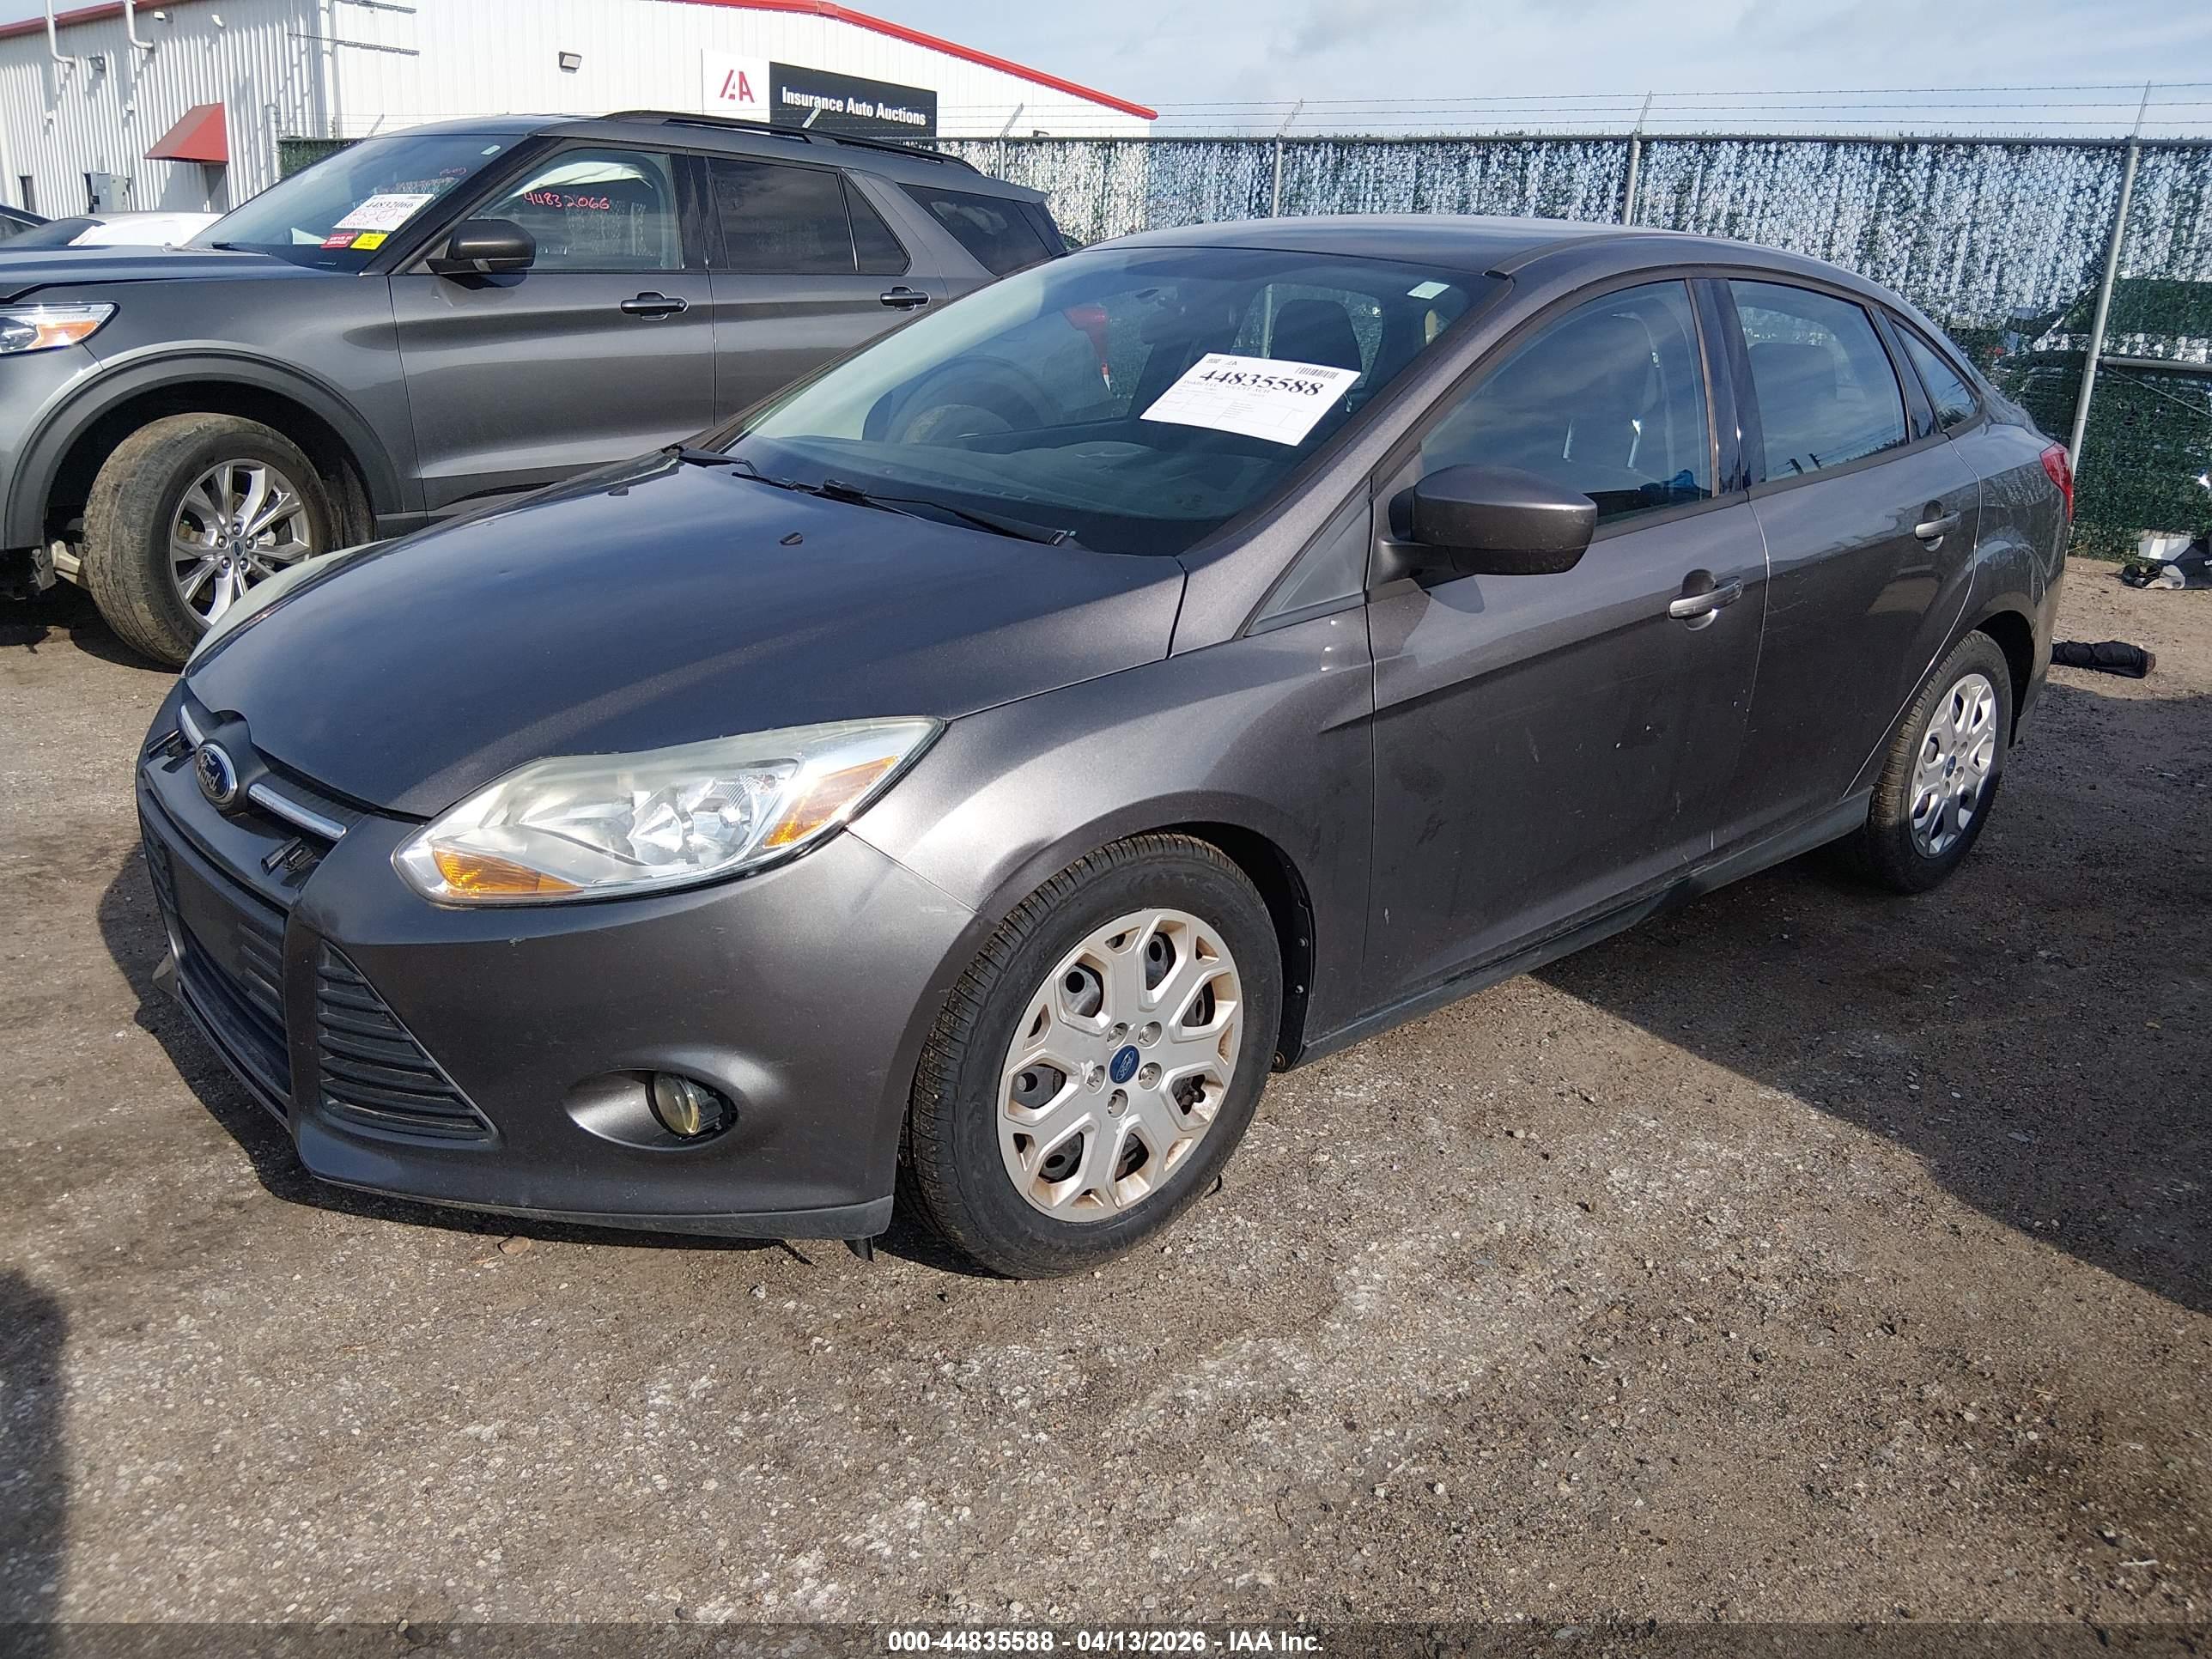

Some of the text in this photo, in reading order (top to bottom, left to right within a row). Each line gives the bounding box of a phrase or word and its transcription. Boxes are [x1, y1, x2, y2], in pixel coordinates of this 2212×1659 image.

[781, 86, 927, 126] Insurance Auto Auctions
[523, 191, 611, 210] 44832066
[1200, 369, 1324, 396] 44835588
[196, 752, 221, 792] Ford
